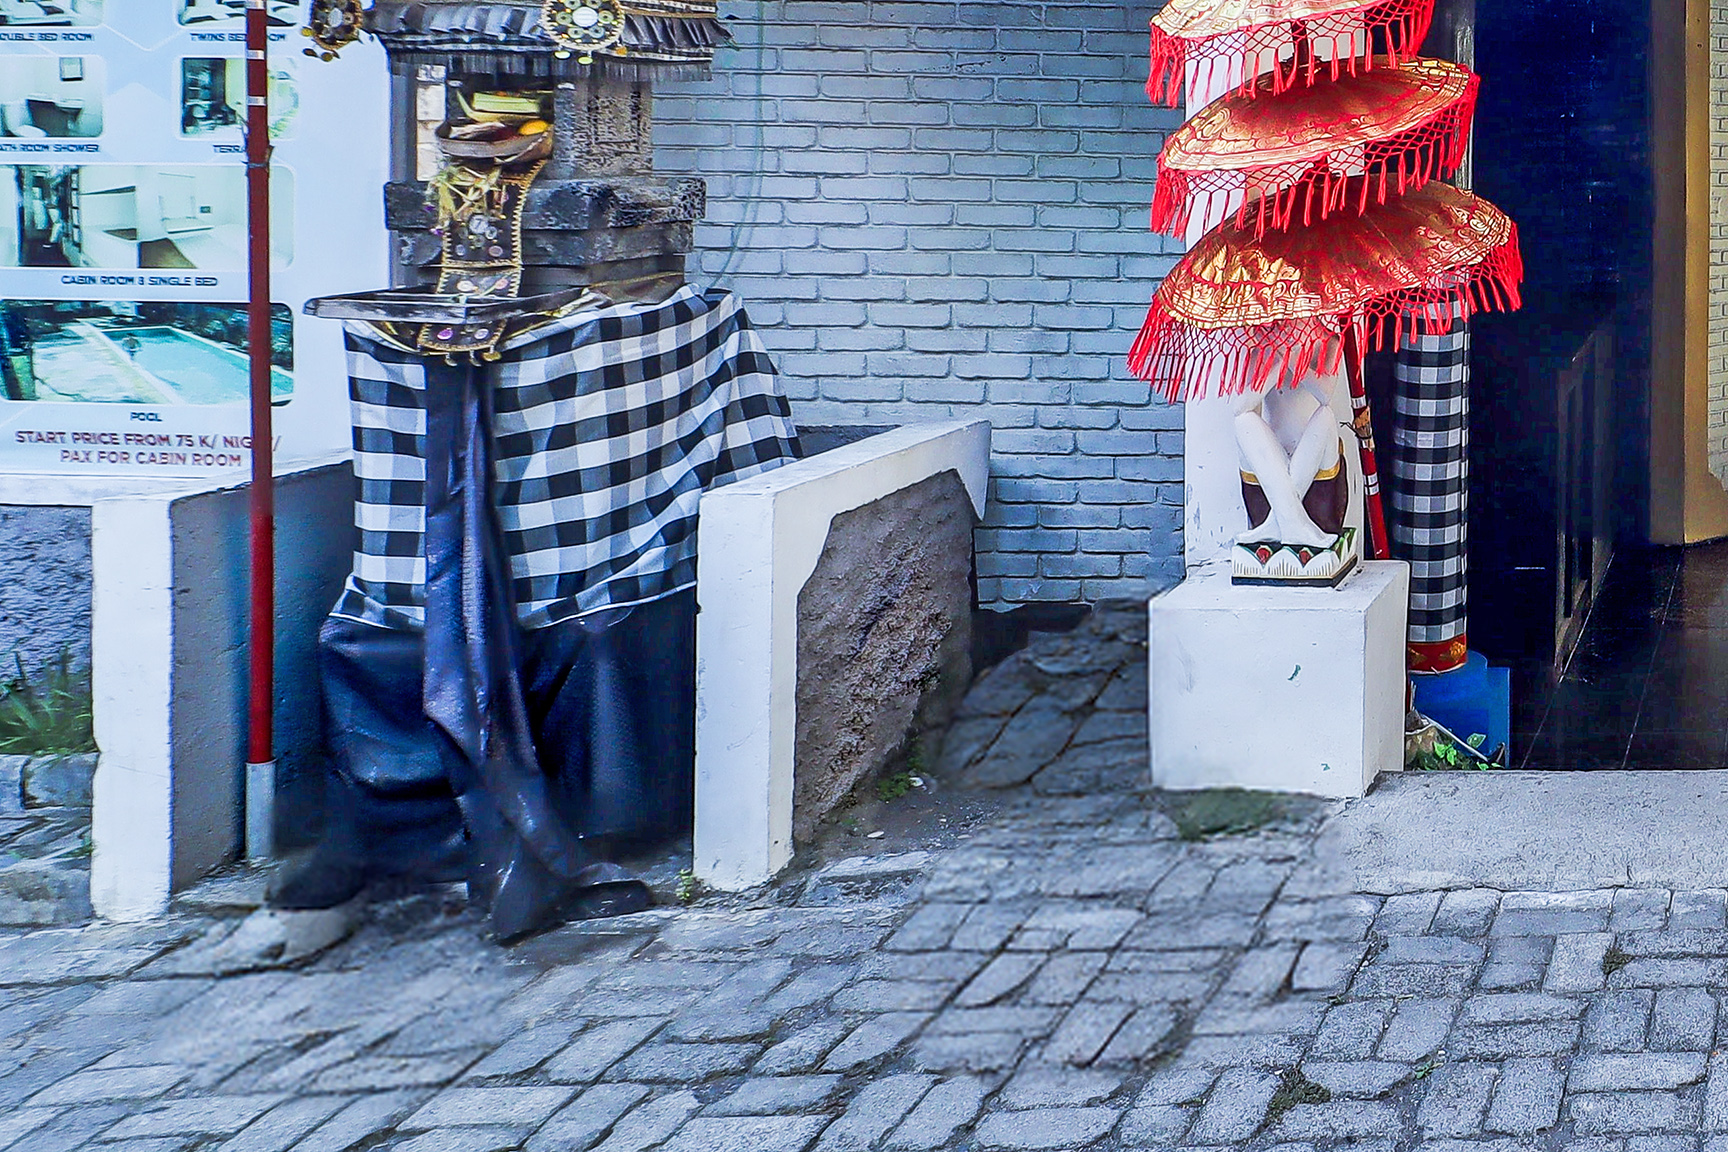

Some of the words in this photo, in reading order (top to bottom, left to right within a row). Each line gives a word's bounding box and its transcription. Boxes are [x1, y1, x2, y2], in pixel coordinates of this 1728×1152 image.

[61, 275, 96, 285] CABIN
[100, 275, 134, 285] ROOM
[149, 276, 193, 286] SINGLE
[130, 412, 162, 422] POOL
[15, 431, 66, 444] START
[72, 432, 120, 445] PRICE
[124, 433, 171, 446] FROM
[176, 435, 194, 446] 75
[60, 450, 91, 463] PAX
[98, 450, 129, 464] FOR
[136, 451, 186, 465] CABIN
[192, 453, 241, 466] ROOM
